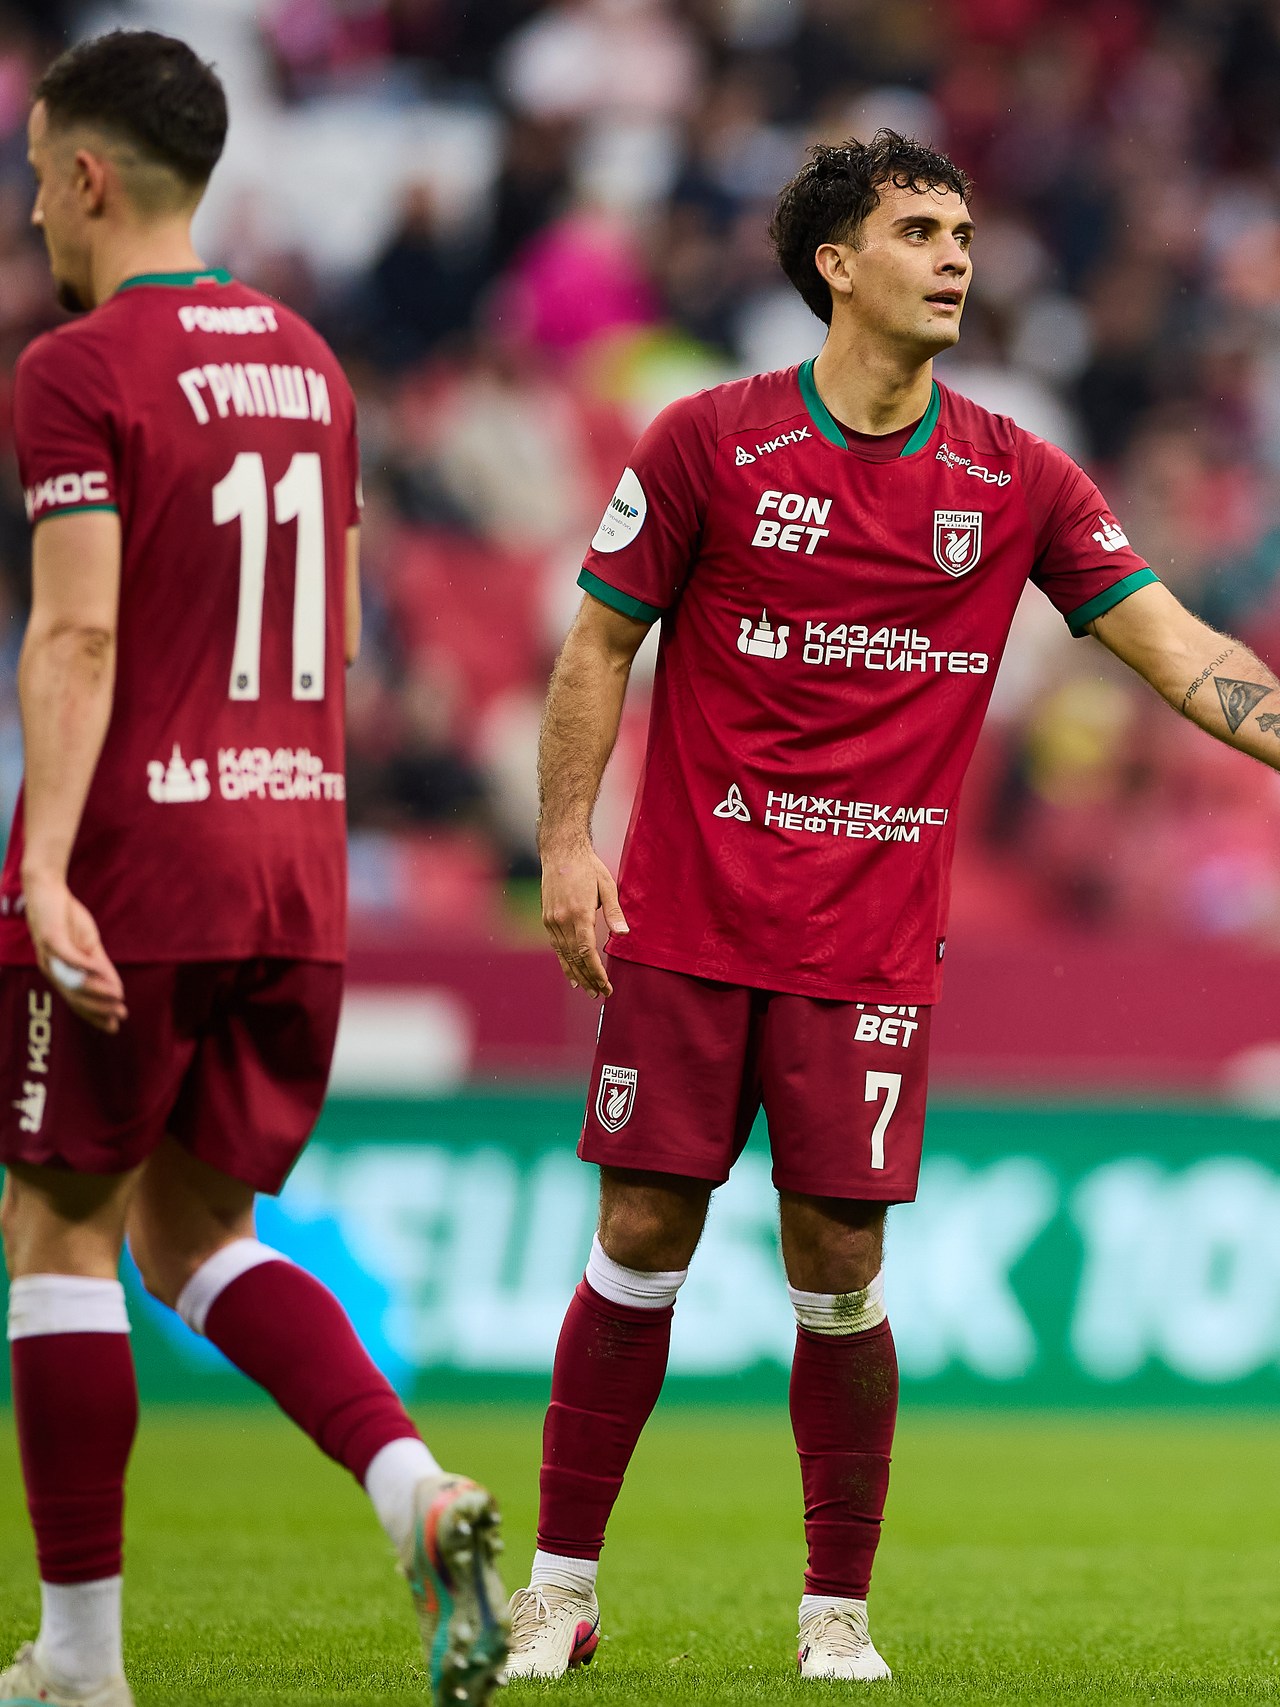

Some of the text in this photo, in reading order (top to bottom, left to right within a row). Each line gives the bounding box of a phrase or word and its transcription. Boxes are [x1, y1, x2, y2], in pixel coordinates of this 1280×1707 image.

[178, 305, 278, 334] FONBET
[177, 363, 331, 425] ГРИПШИ
[756, 426, 812, 456] НКНХ
[948, 451, 971, 466] Барс
[611, 496, 639, 518] МИР
[755, 490, 832, 525] FON
[937, 513, 979, 523] РУБИН
[601, 523, 615, 537] 5/26
[751, 520, 829, 555] BET
[212, 452, 326, 701] 11
[805, 620, 930, 650] КАЗАНЬ
[802, 644, 989, 674] ОРГСИНТЕЗ
[218, 747, 323, 775] КАЗАНЬ
[766, 790, 949, 825] НИЖНЕКАМС
[764, 810, 920, 843] НЕФТЕХИМ
[27, 988, 51, 1073] КОС
[854, 1013, 918, 1048] BET
[604, 1068, 636, 1080] РУБИН
[865, 1070, 902, 1169] 7
